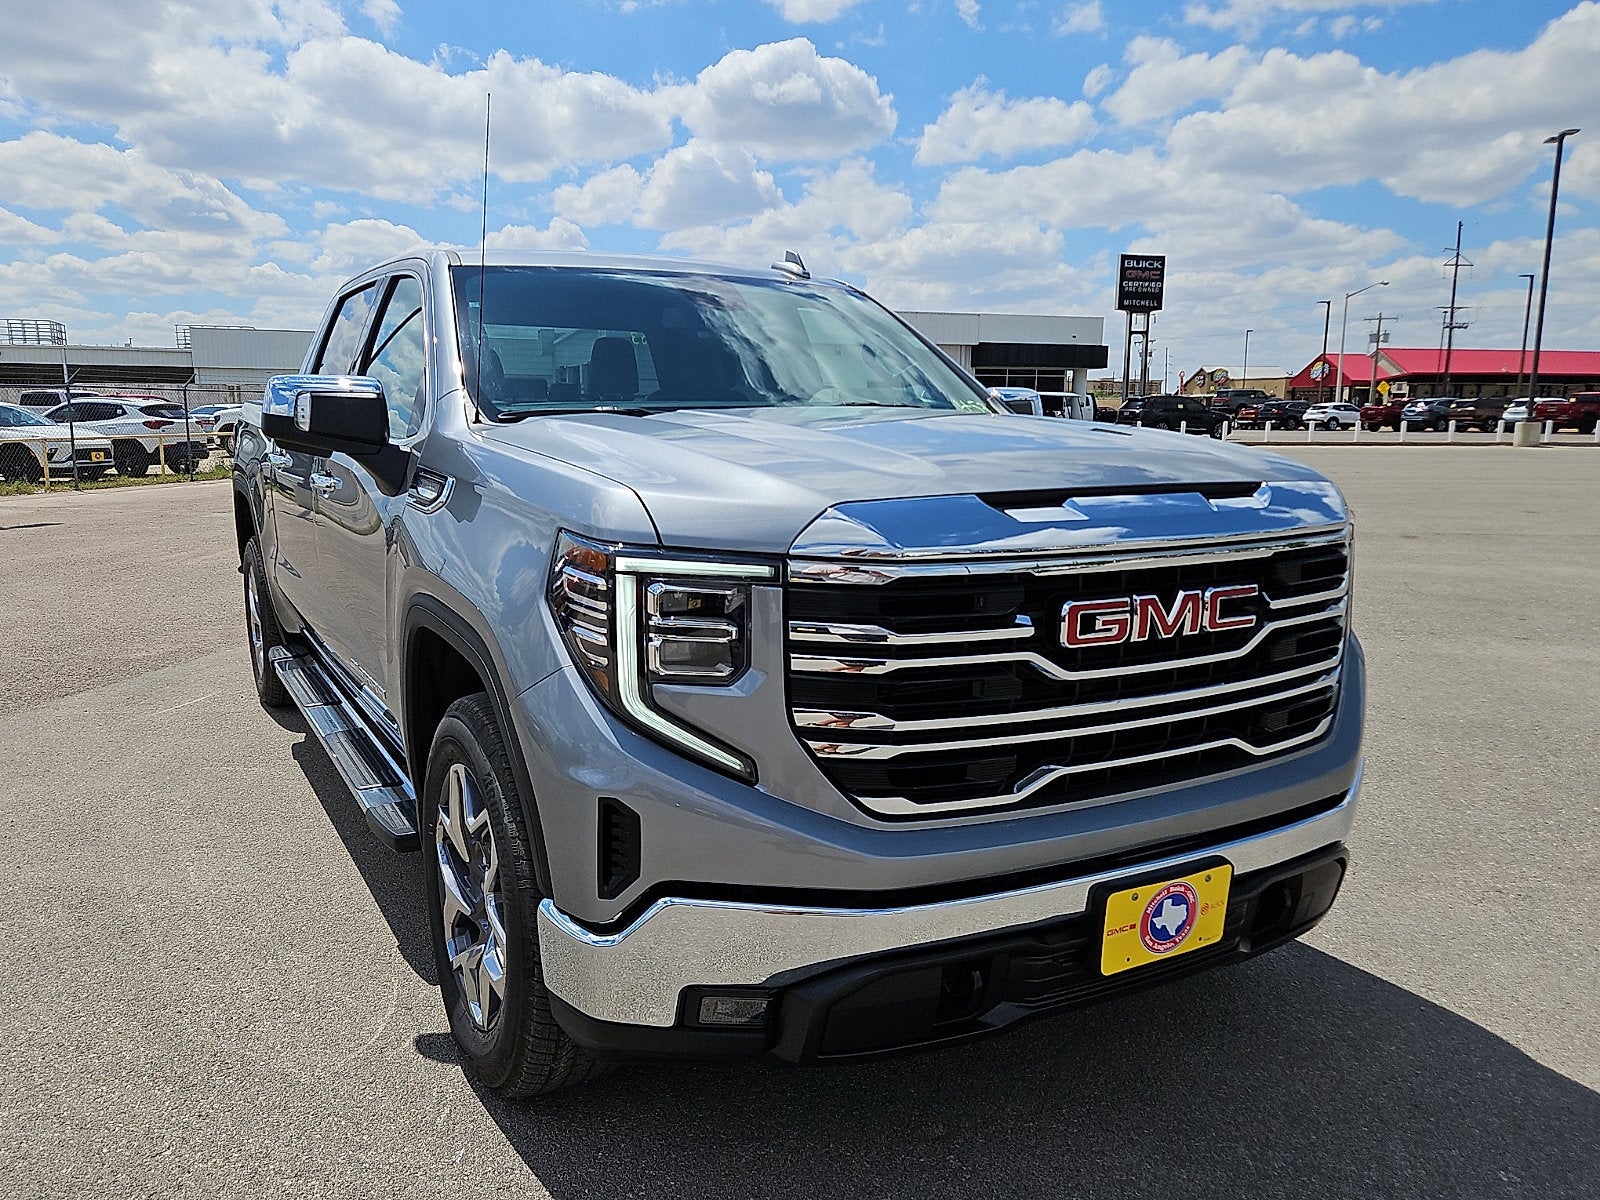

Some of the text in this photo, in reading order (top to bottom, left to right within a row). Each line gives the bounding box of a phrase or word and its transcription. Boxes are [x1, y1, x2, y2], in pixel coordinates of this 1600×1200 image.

[1124, 260, 1163, 268] BUICK
[1125, 270, 1161, 279] GMC
[1123, 299, 1158, 307] MITCHELL
[1060, 584, 1259, 648] GMC
[1146, 890, 1168, 914] Mitchell
[1106, 925, 1129, 937] GMC
